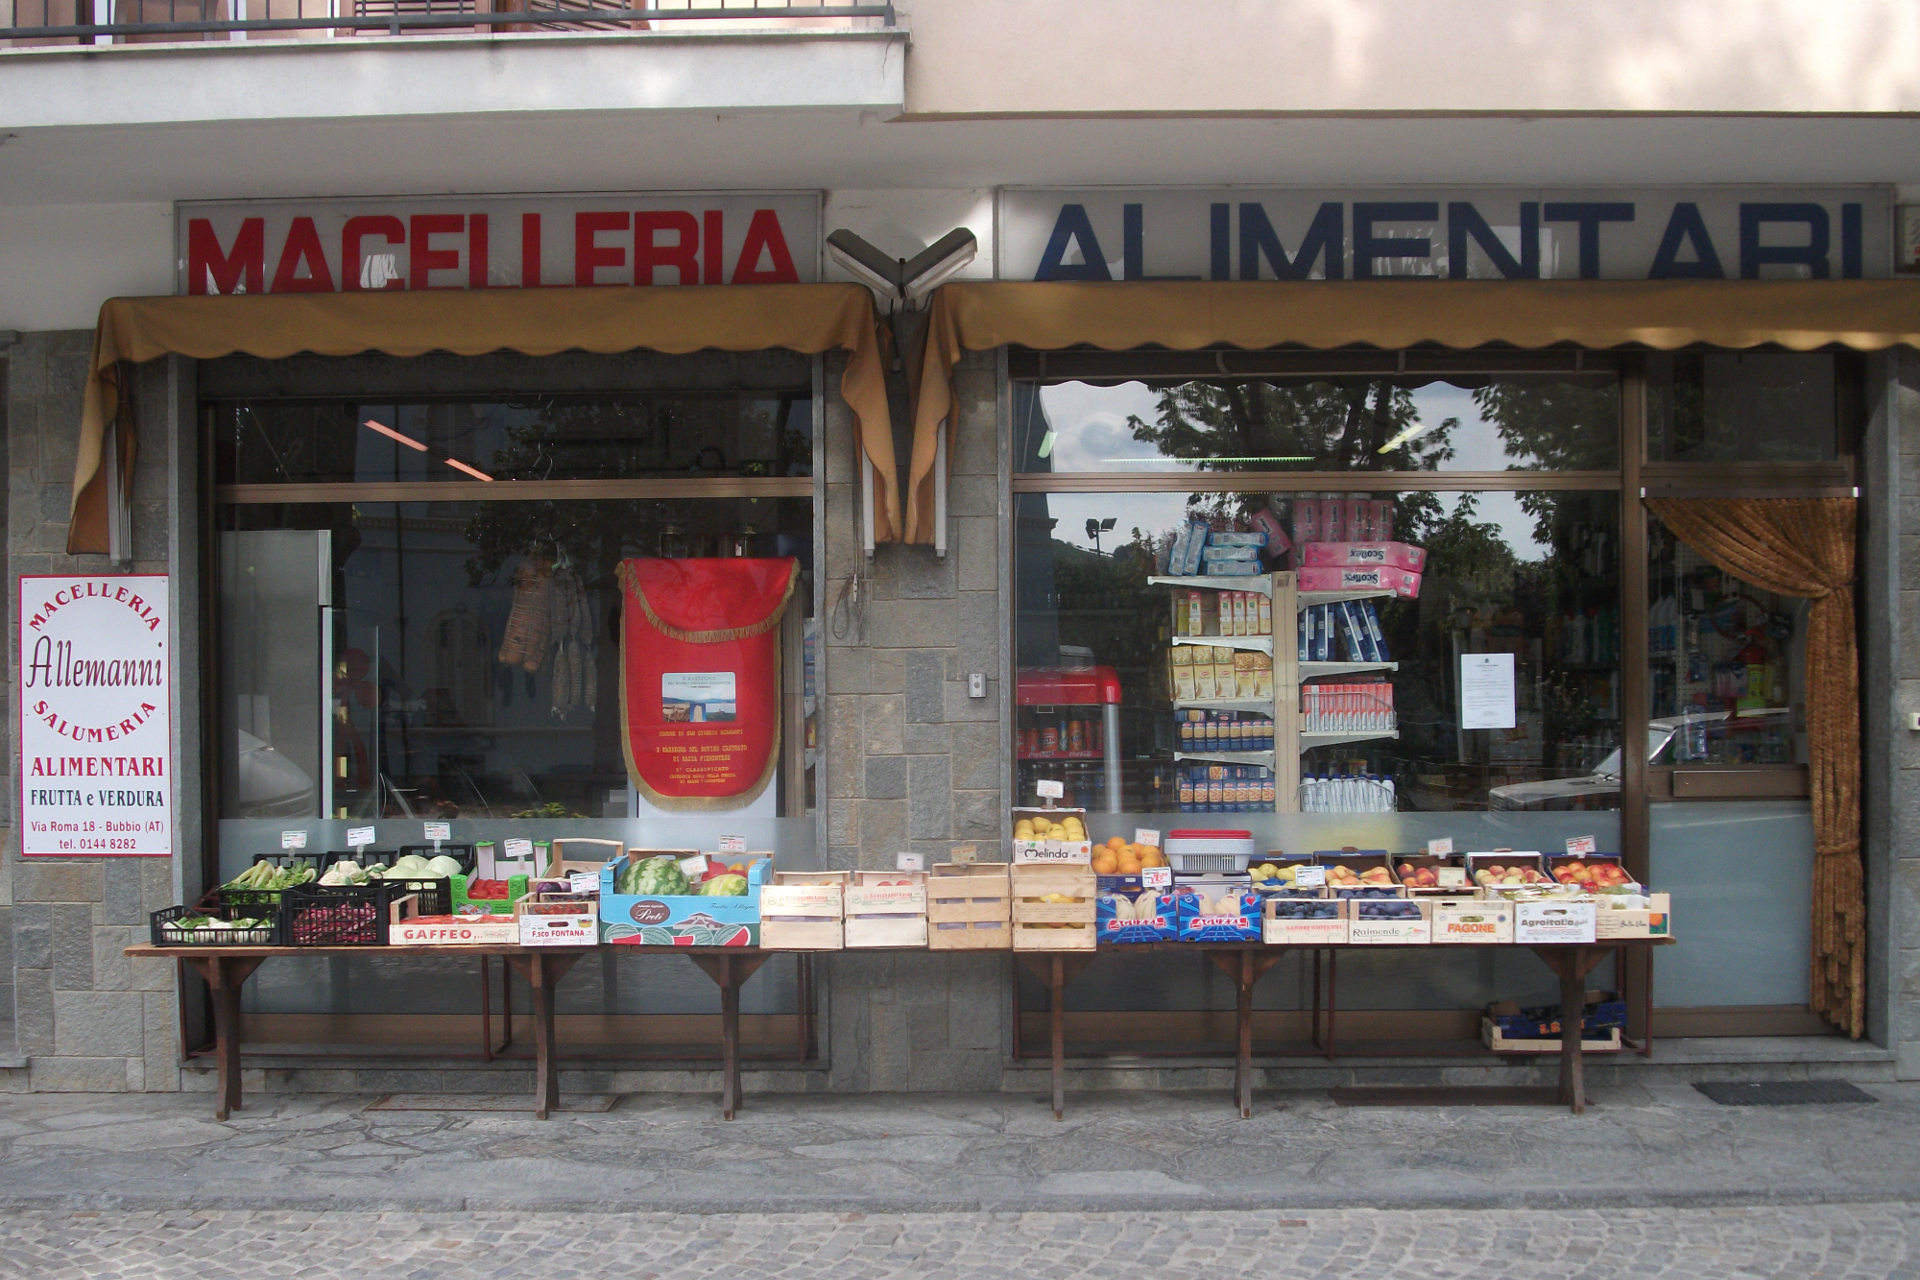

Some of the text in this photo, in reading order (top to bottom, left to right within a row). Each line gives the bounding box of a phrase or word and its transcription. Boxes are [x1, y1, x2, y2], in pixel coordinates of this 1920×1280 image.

[1033, 201, 1863, 282] ALIMENTARI
[188, 209, 799, 294] MACELLERIA
[1348, 549, 1385, 561] Scottex
[29, 582, 161, 632] MACELLERIA
[26, 635, 163, 688] Allemanni
[33, 700, 157, 743] SALUMERIA
[700, 745, 720, 753] BOVINO
[722, 744, 748, 752] CASTRATO
[699, 754, 731, 762] PIEMONTESE
[30, 757, 164, 777] ALIMENTARI
[31, 789, 165, 807] FRUTTA e VERDURA
[31, 821, 47, 832] Via
[50, 821, 79, 832] Roma
[82, 821, 96, 832] 18
[105, 820, 141, 832] Bubbio
[144, 821, 164, 834] (AT)
[59, 839, 137, 850] tel. 0144 8282
[1024, 848, 1069, 858] Melinda
[551, 929, 585, 937] FONTANA
[1447, 923, 1497, 933] FAGONE
